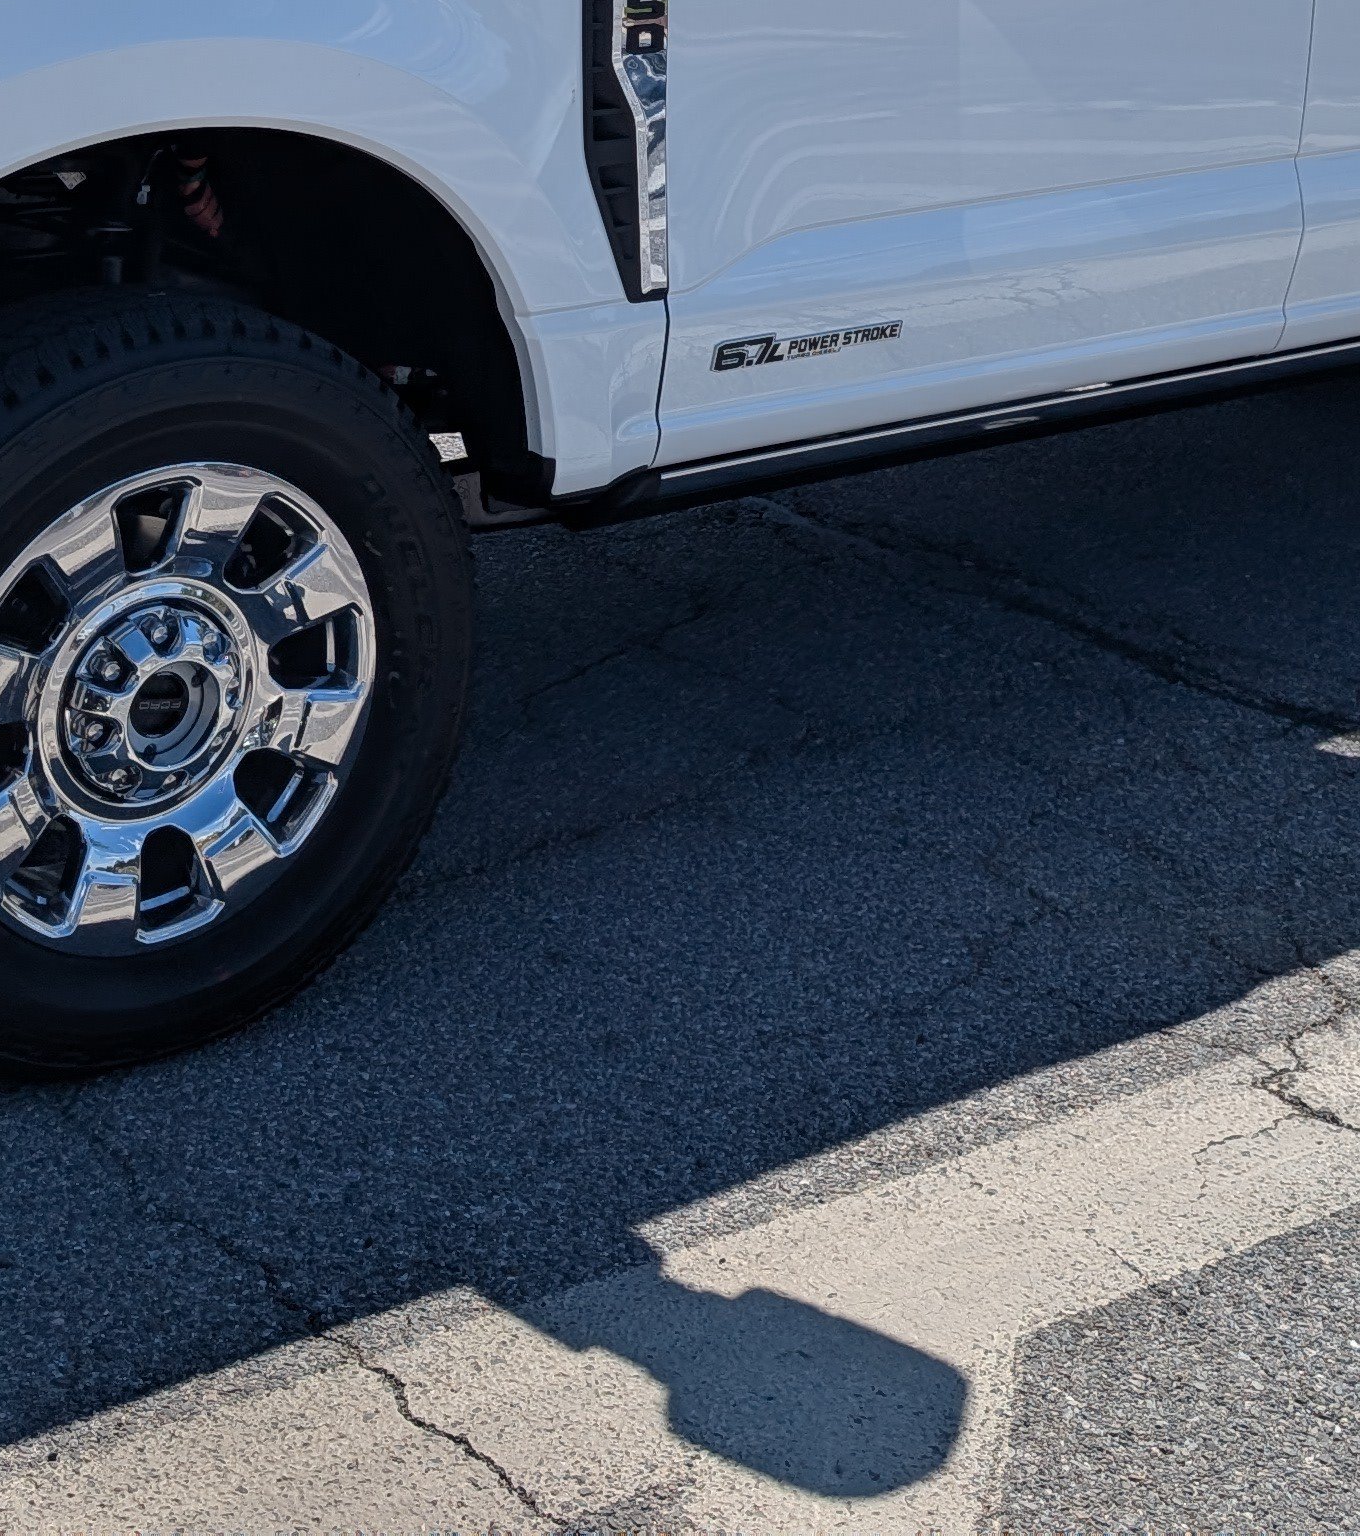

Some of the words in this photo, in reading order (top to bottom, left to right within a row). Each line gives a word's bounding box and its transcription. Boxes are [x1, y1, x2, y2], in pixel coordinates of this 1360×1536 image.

[714, 336, 785, 371] 6.7L
[787, 334, 840, 353] POWER
[841, 323, 900, 346] STROKE
[138, 699, 182, 711] FORD
